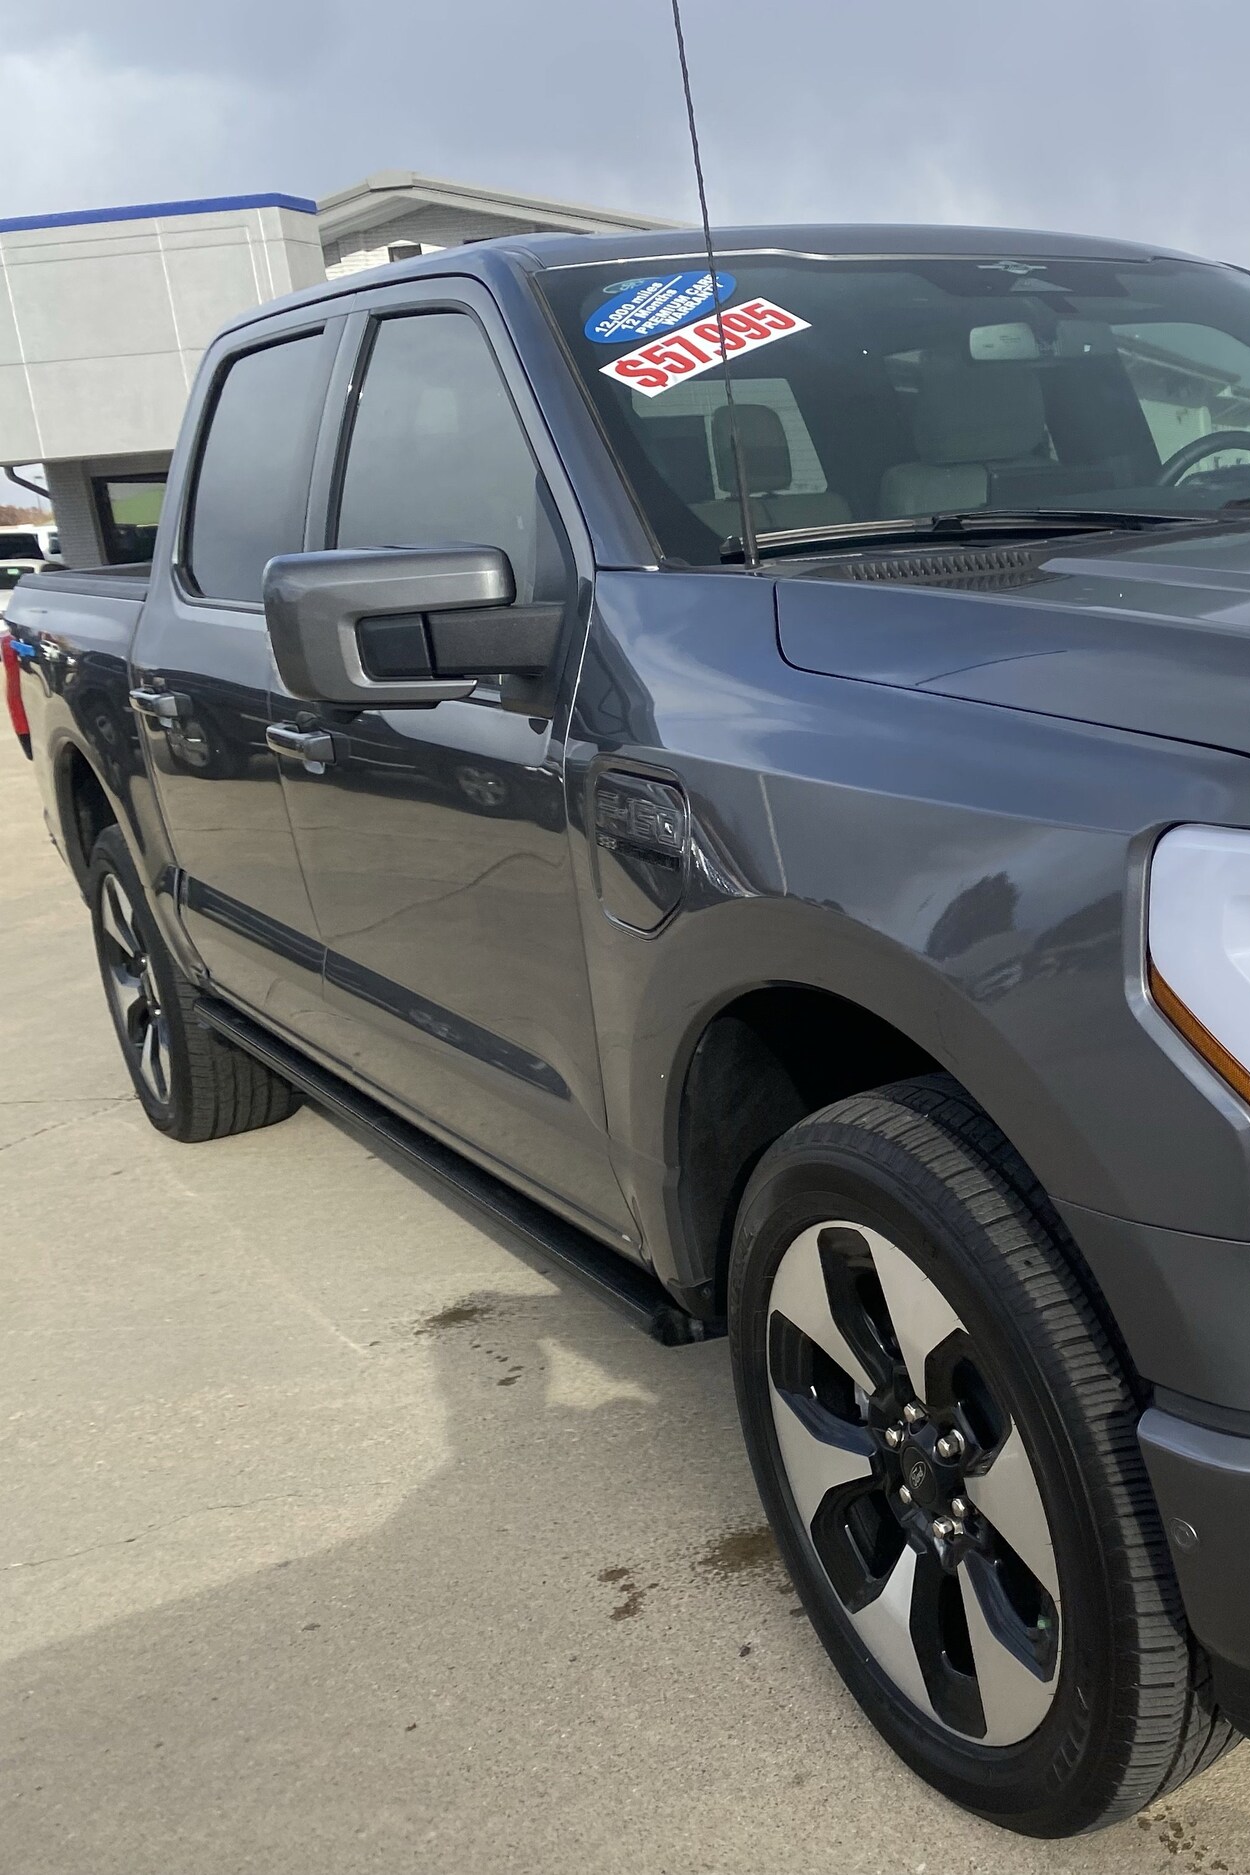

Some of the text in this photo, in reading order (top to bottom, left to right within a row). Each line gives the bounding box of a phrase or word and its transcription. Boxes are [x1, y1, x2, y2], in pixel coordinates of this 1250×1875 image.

[594, 303, 636, 333] 12,000
[631, 282, 663, 304] miles
[621, 289, 677, 330] 12 Months
[635, 294, 692, 335] PREMIUM
